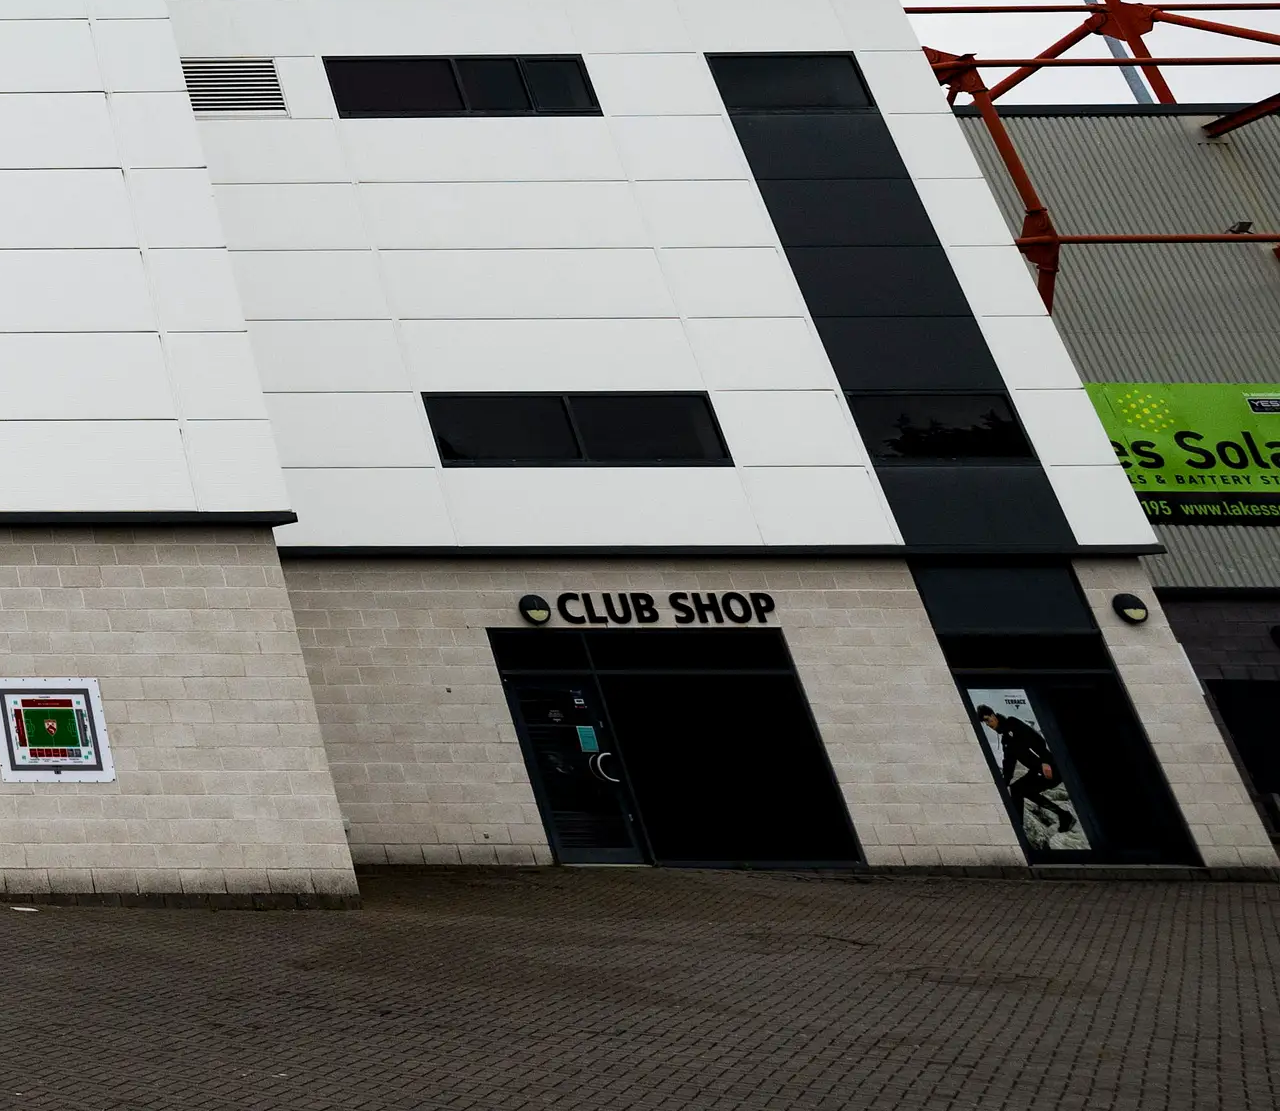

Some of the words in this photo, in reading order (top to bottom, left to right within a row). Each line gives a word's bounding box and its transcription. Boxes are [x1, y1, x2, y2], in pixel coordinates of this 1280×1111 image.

[1155, 474, 1167, 485] &
[1174, 474, 1252, 485] BATTERY
[1141, 500, 1172, 516] 195
[1180, 500, 1280, 516] www.lakess
[557, 592, 659, 624] CLUB
[668, 591, 775, 624] SHOP
